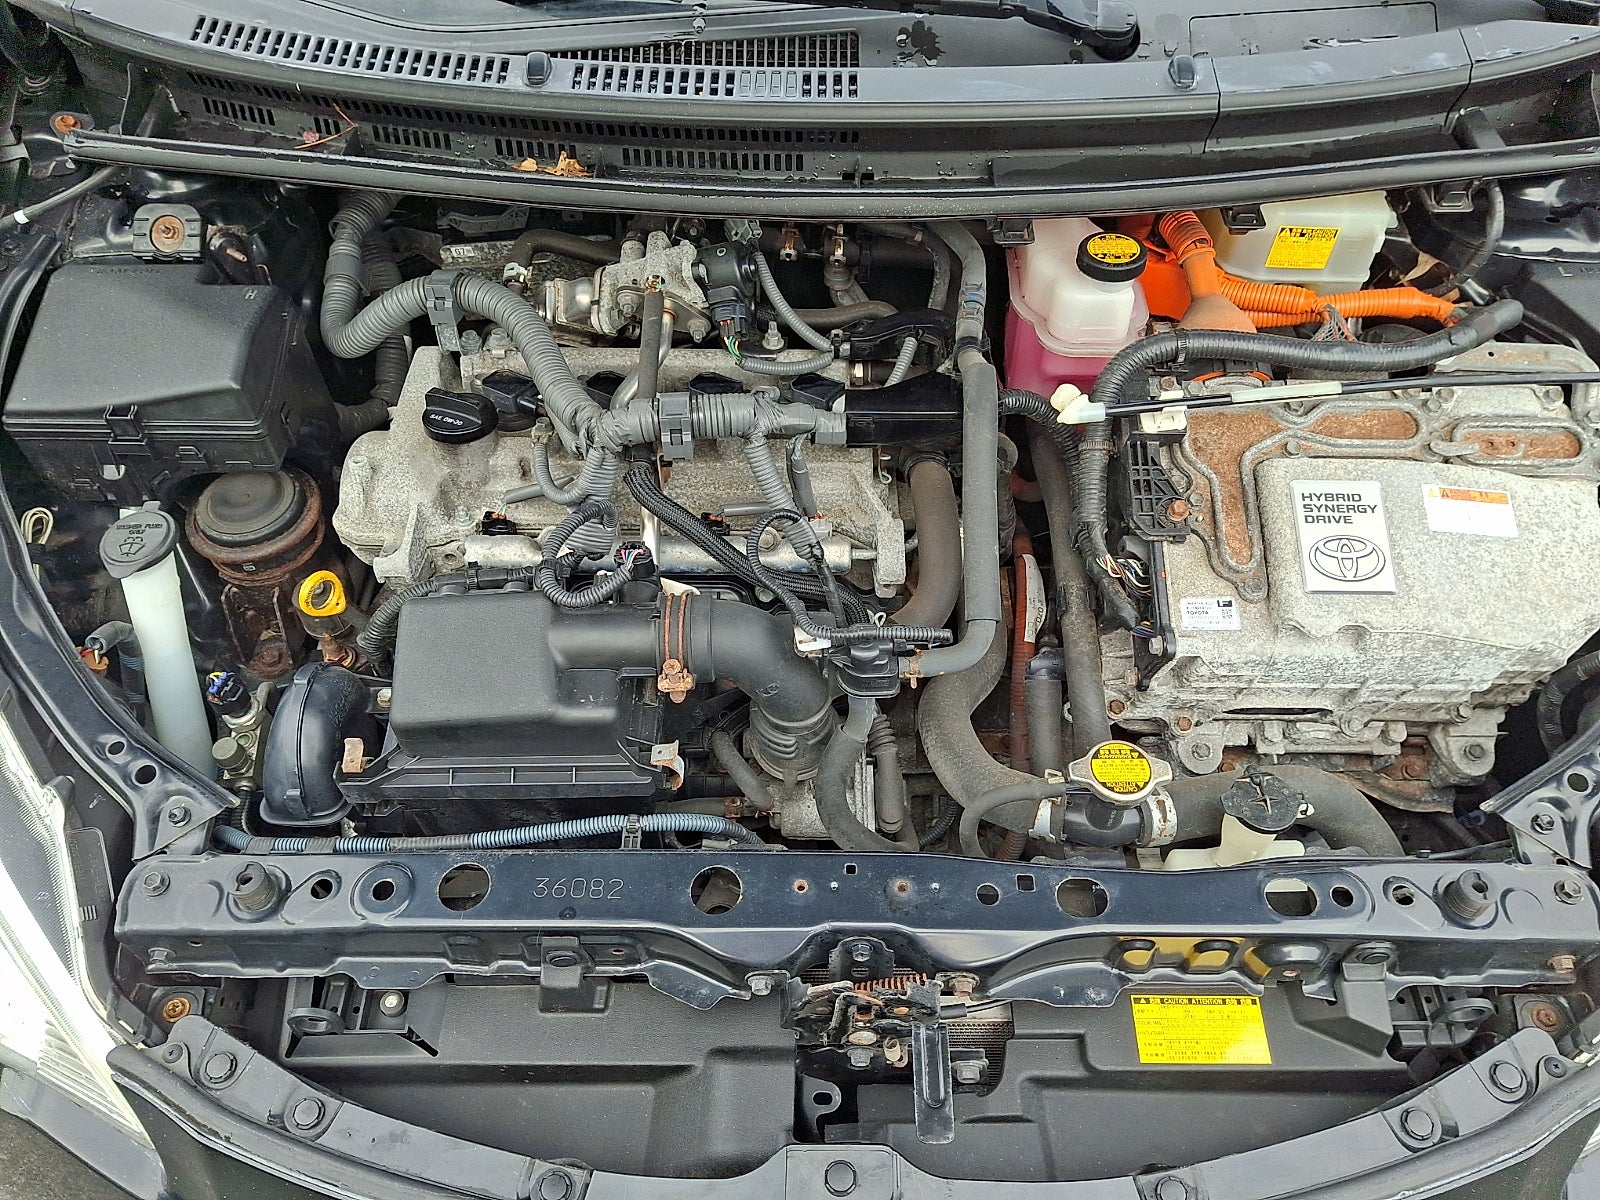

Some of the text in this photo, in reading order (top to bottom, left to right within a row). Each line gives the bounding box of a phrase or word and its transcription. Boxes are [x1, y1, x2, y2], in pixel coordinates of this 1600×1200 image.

[429, 413, 443, 421] SAE
[1301, 492, 1362, 502] HYBRID
[1302, 503, 1378, 514] SYNERGY
[1304, 515, 1354, 524] DRIVE
[533, 877, 624, 899] 36082
